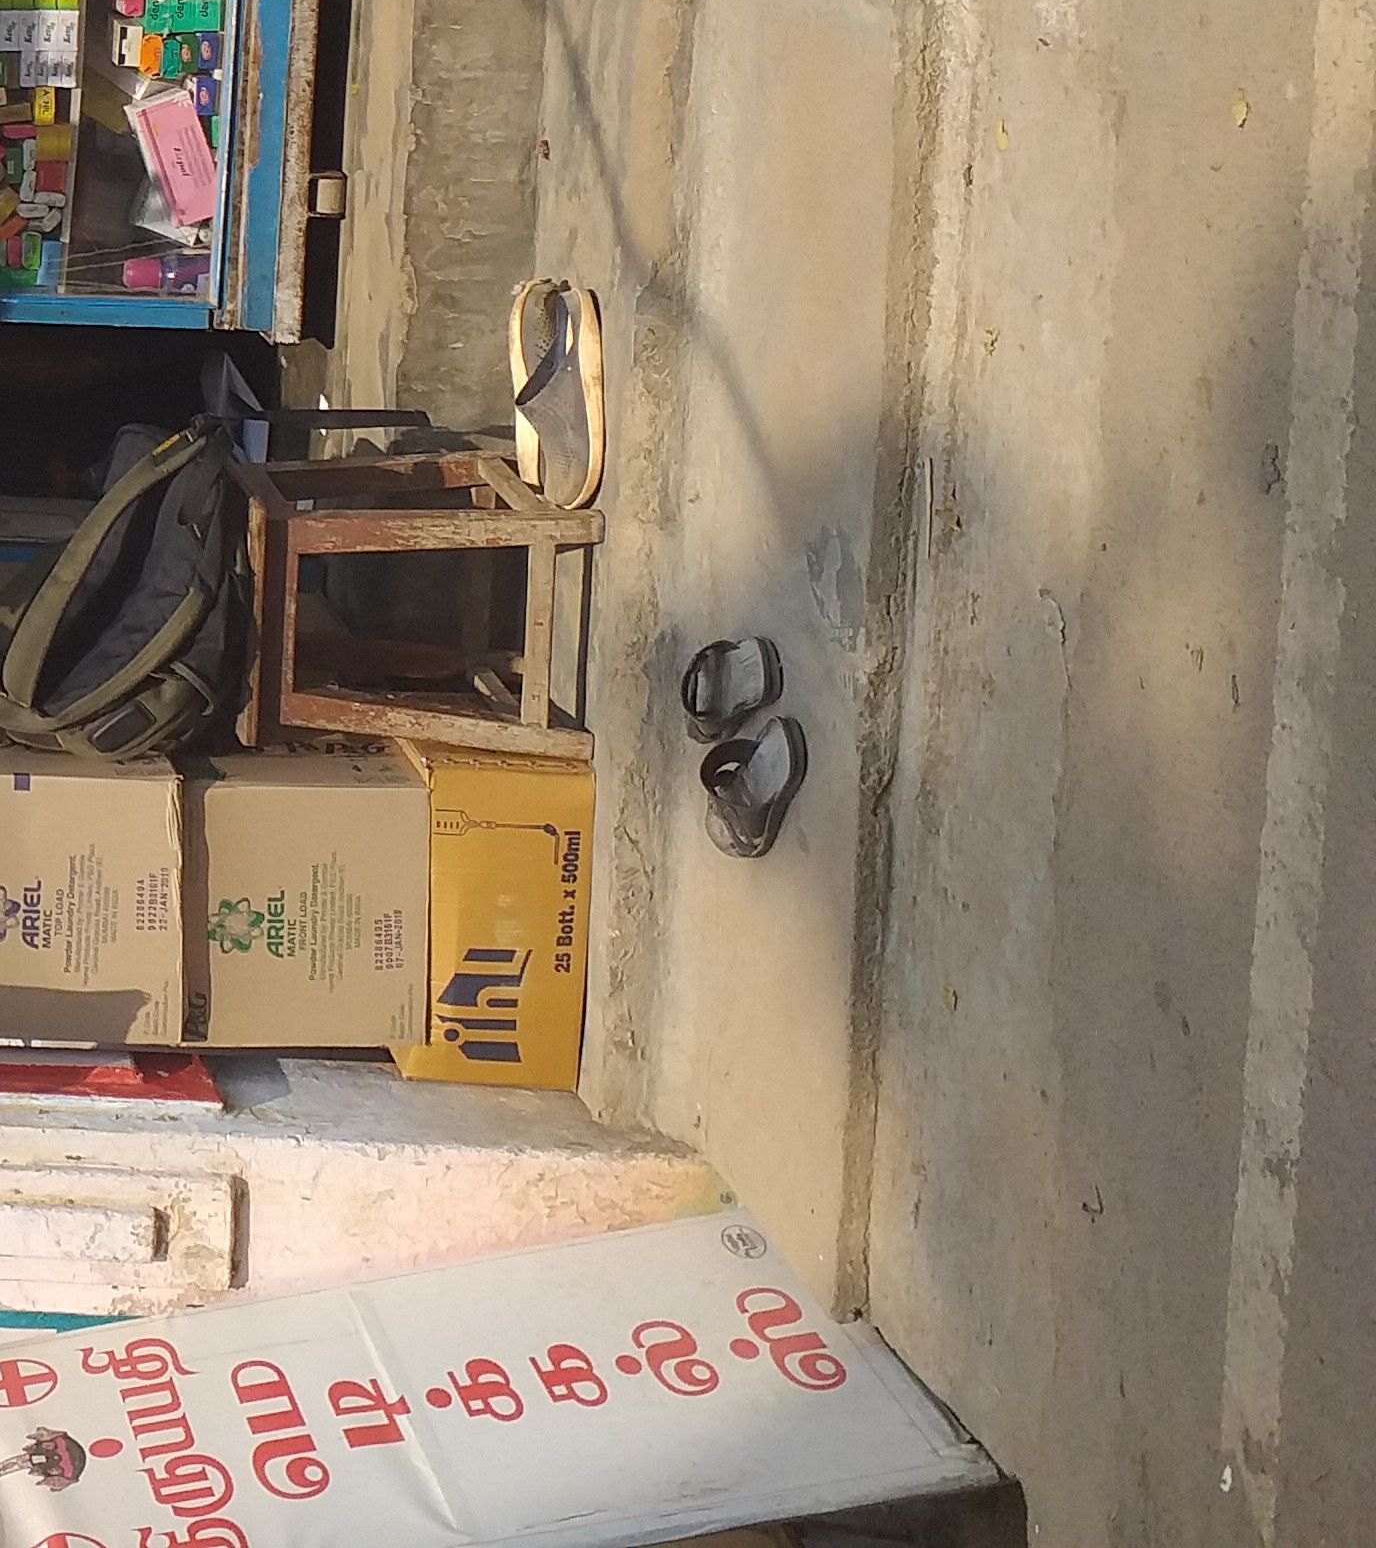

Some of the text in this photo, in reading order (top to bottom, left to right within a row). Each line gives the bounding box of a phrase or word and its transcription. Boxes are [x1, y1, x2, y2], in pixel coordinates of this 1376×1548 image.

[21, 879, 42, 951] ARIEL
[65, 901, 76, 938] Laundry
[555, 829, 581, 974] 25 Bott. x 500ml
[42, 909, 53, 949] MATIC
[266, 888, 286, 959] ARIEL
[287, 919, 297, 958] MATIC
[63, 939, 73, 974] Powder
[308, 947, 318, 982] Powder
